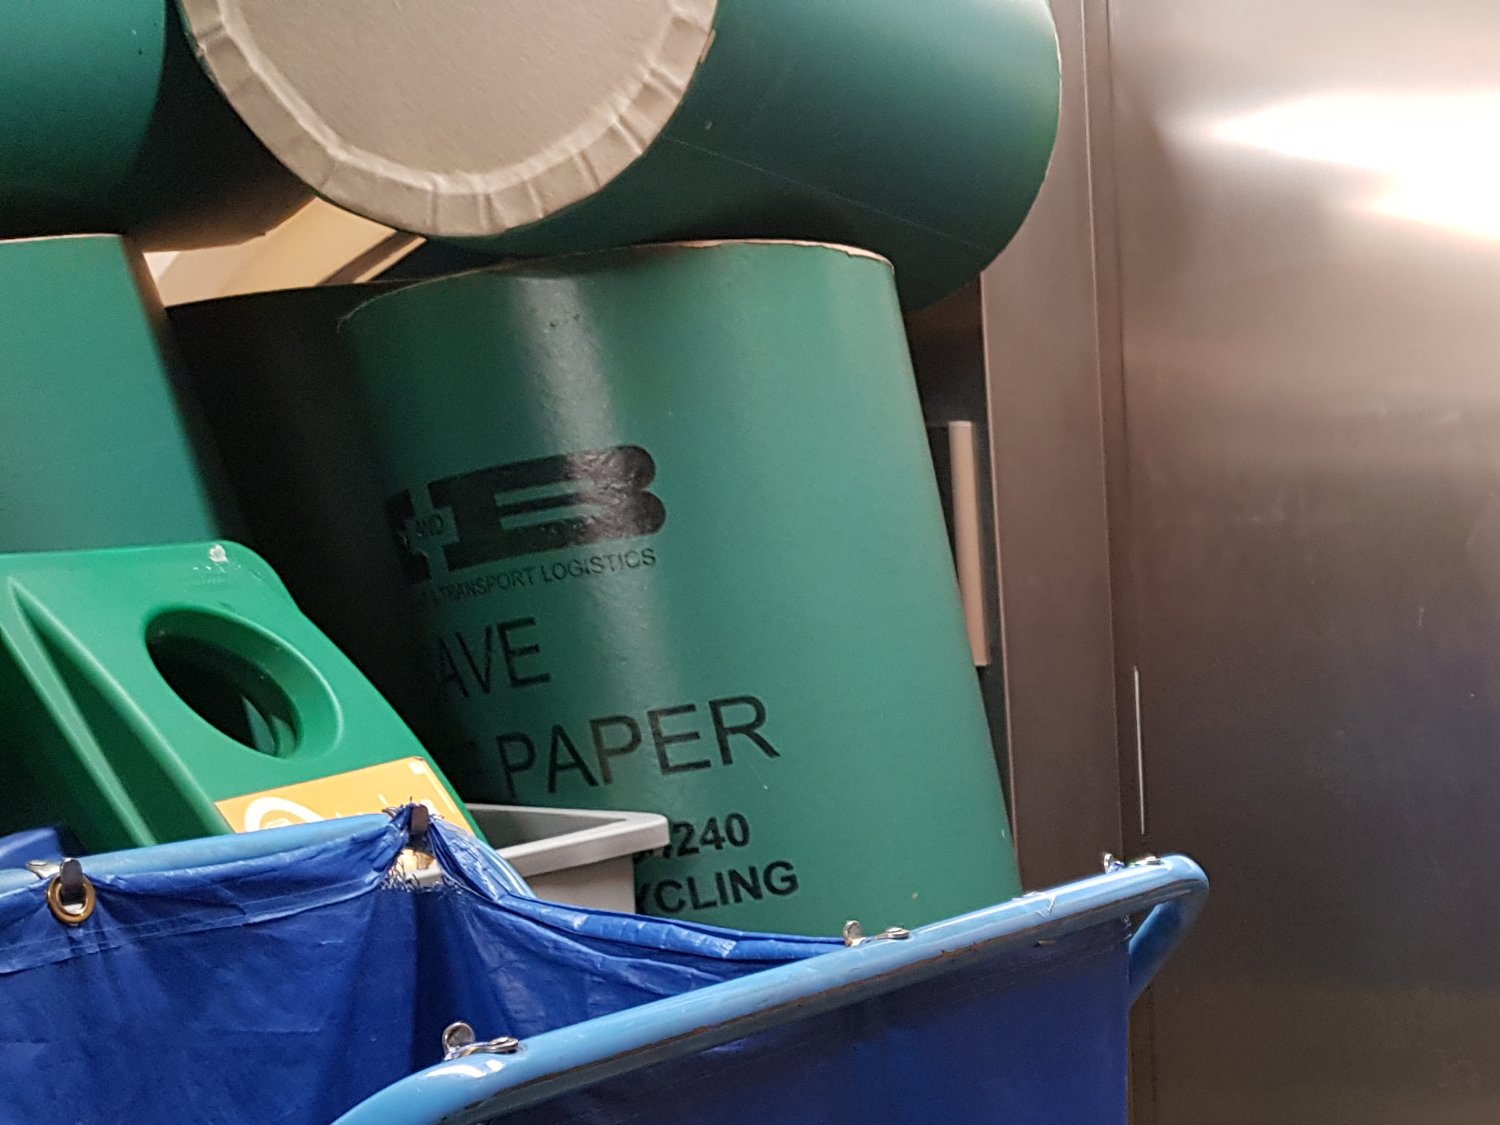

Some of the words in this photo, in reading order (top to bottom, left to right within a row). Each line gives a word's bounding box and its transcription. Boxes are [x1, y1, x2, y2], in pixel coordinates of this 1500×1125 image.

[438, 565, 536, 603] TRANSPORT
[541, 547, 656, 583] LOGISTICS
[438, 616, 550, 702] AVE
[496, 694, 781, 798] PAPER
